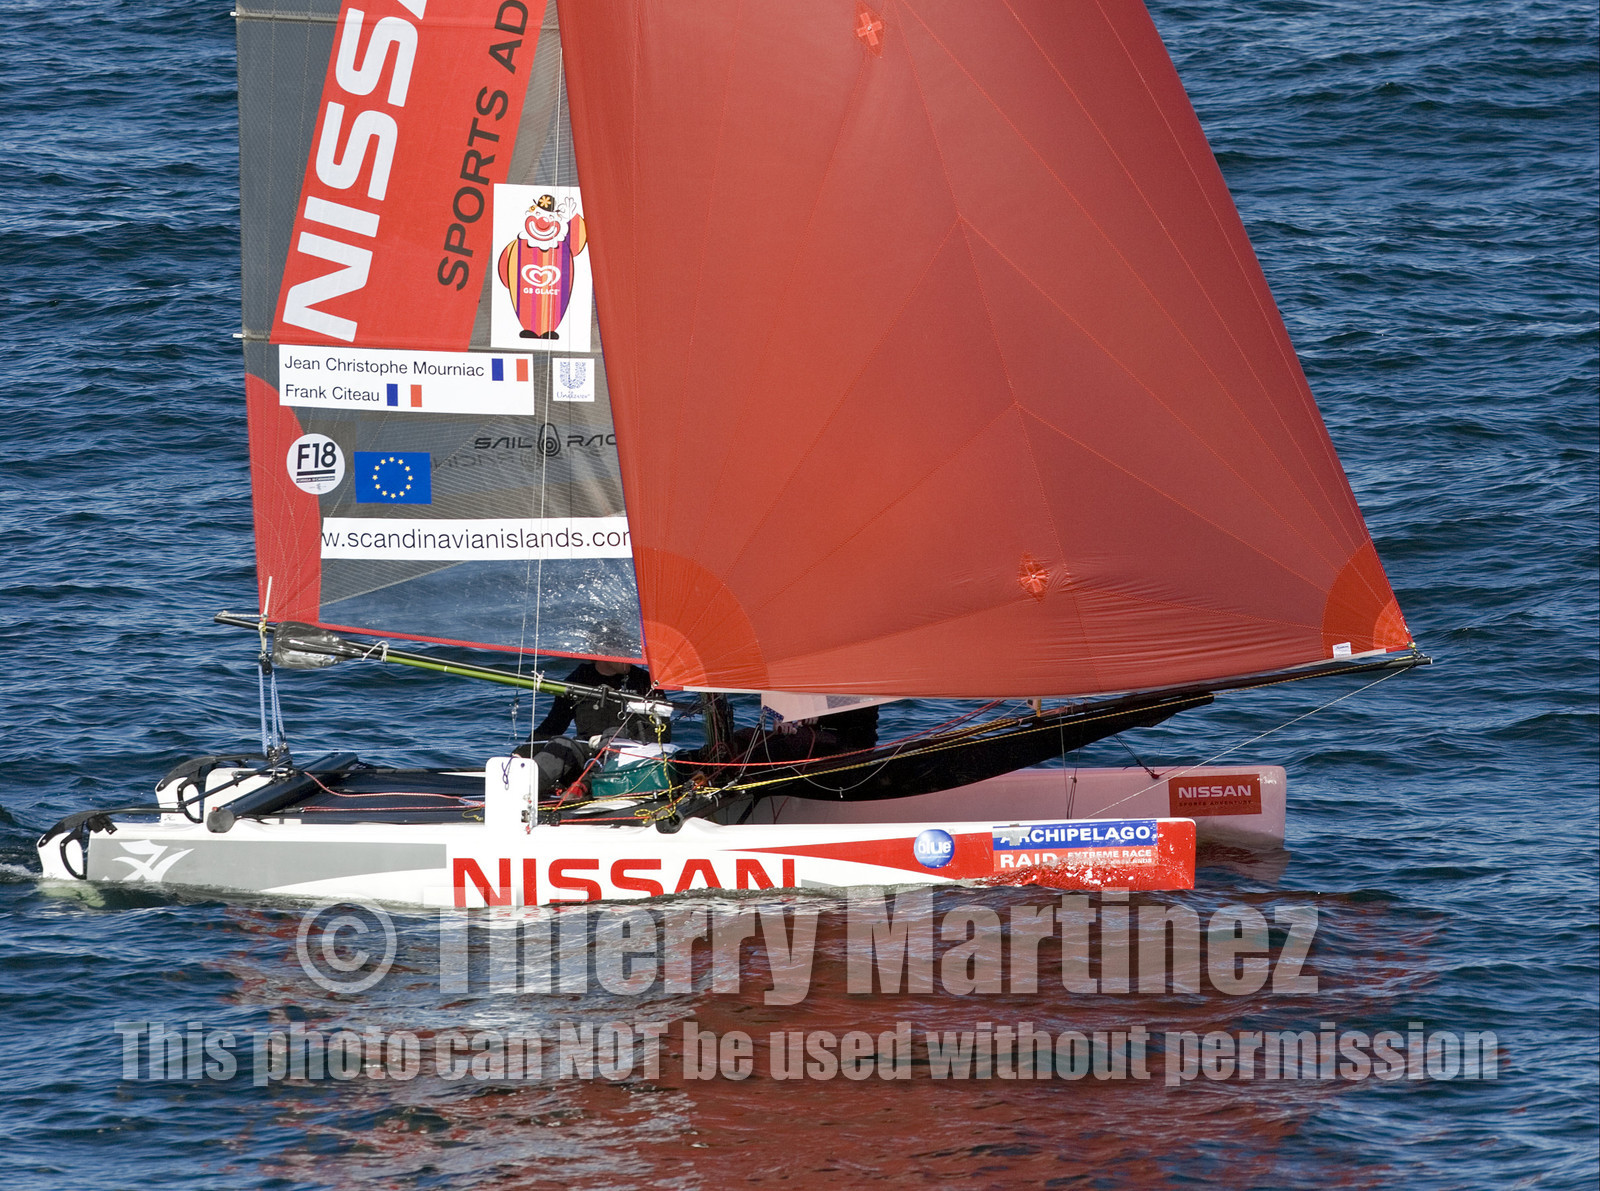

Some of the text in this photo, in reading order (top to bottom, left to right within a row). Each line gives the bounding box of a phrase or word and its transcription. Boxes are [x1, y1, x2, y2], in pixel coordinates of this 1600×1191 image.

[436, 86, 510, 292] SPORTS
[284, 355, 485, 377] Jean Christophe Mourniac
[285, 384, 380, 402] Frank Citeau
[474, 437, 533, 449] SAIL
[297, 441, 337, 470] F18
[1178, 785, 1252, 799] NISSAN
[918, 840, 951, 855] blue
[1122, 849, 1152, 857] RACE
[452, 857, 796, 908] NISSAN
